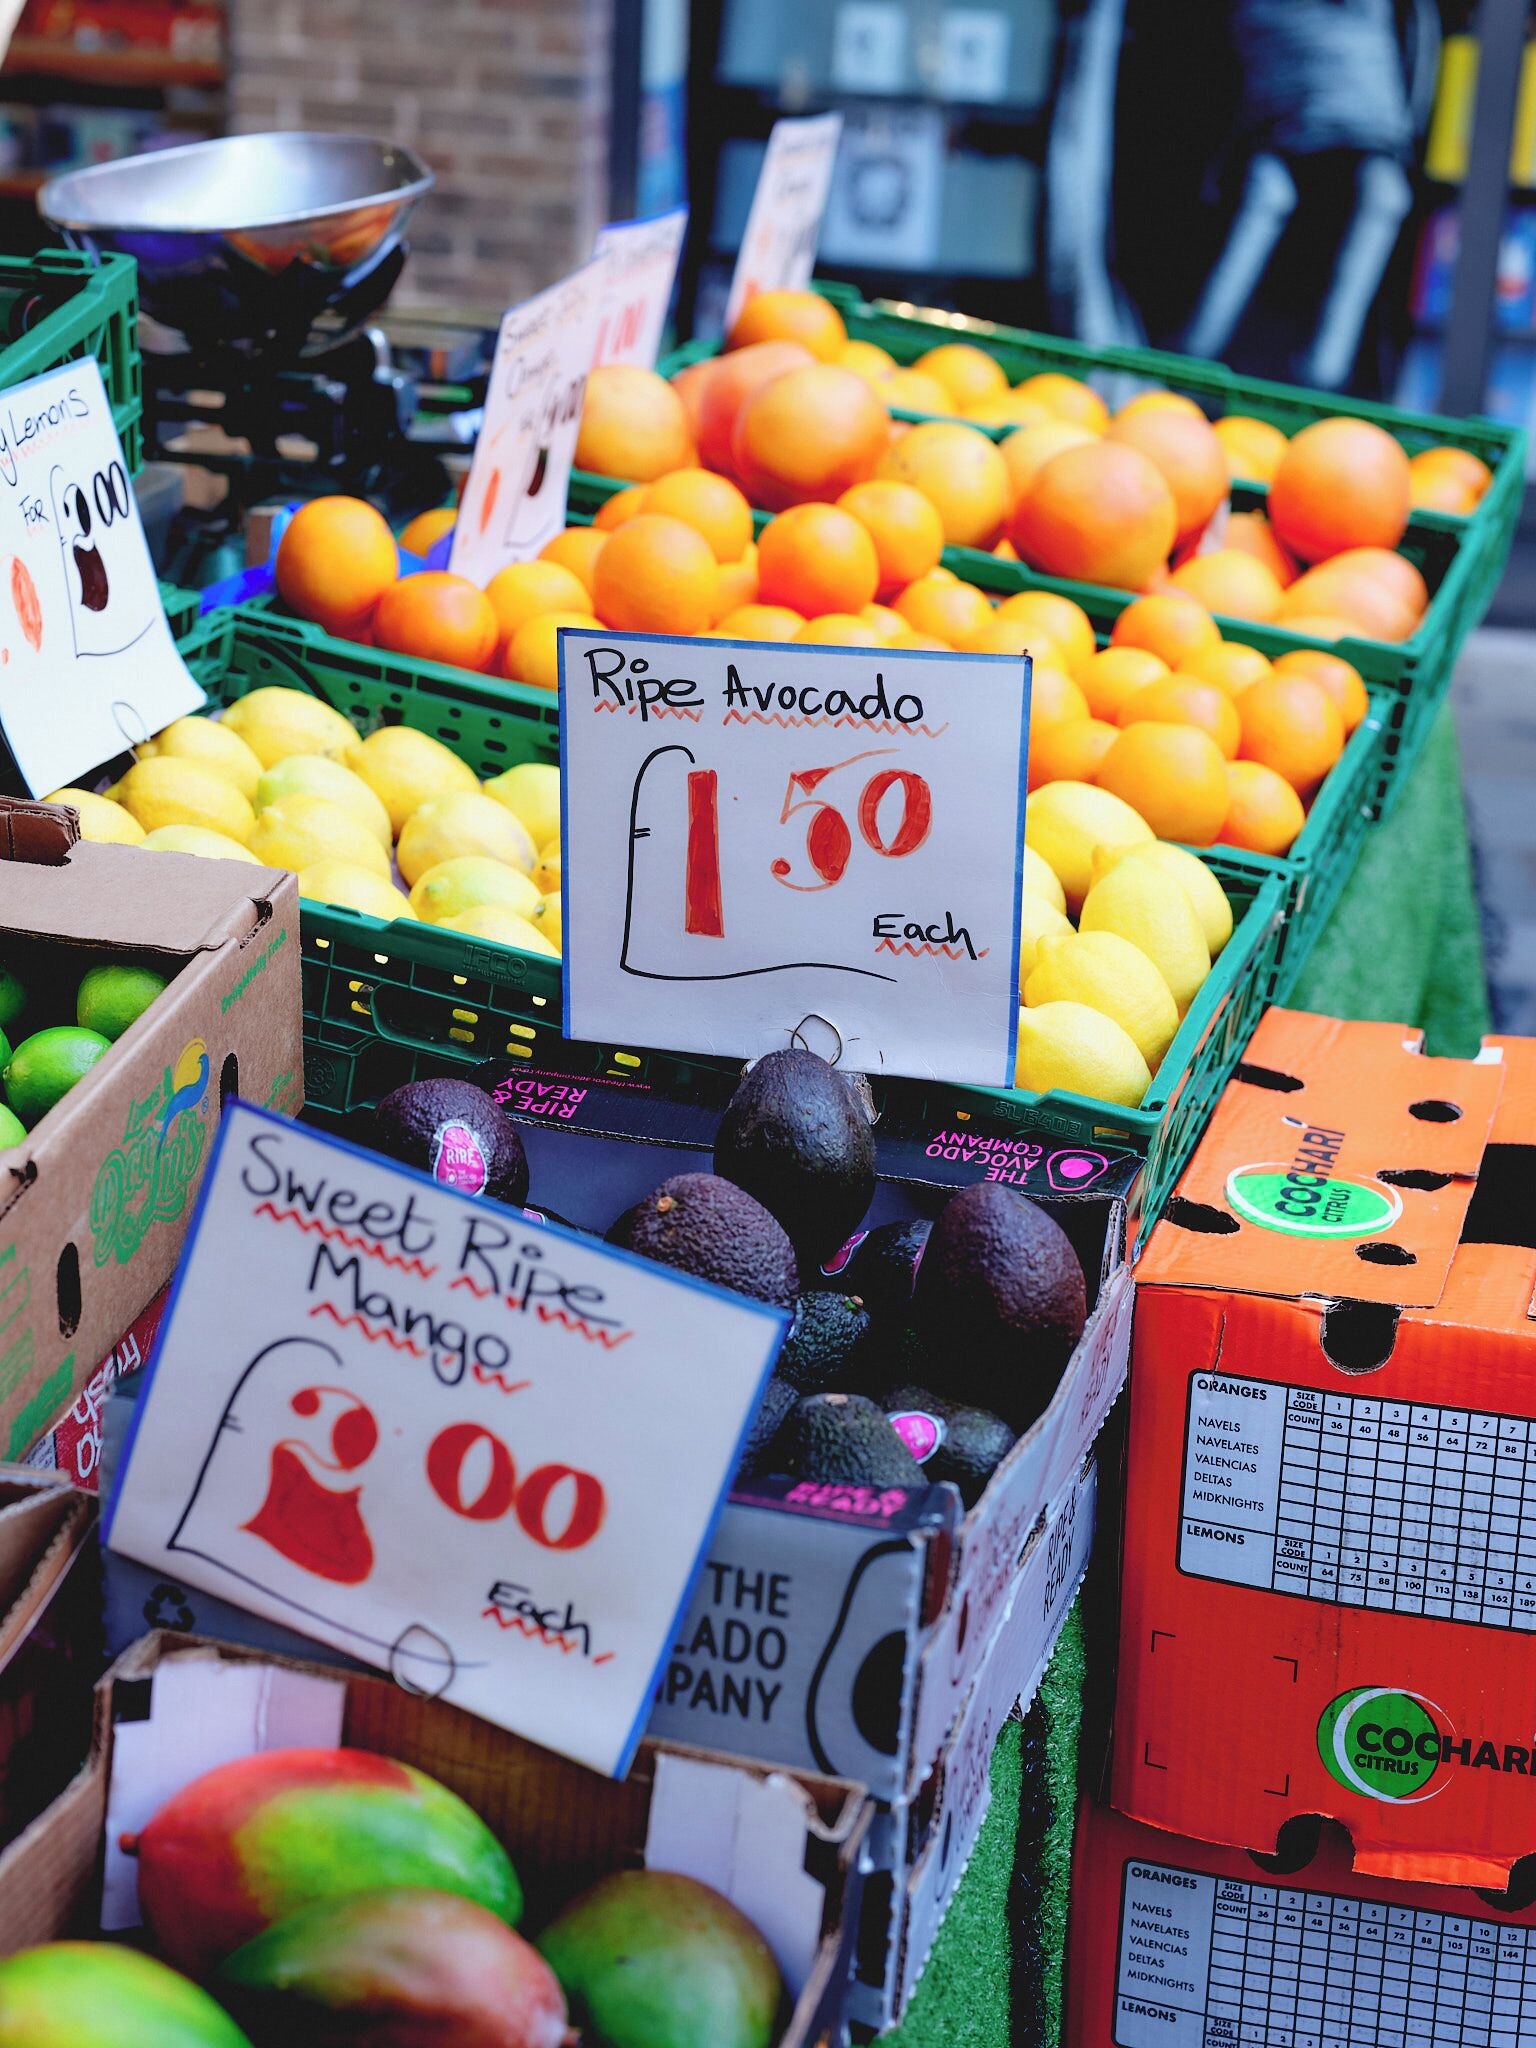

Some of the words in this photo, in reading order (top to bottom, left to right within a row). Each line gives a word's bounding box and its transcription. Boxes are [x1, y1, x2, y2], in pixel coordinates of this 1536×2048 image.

[9, 389, 89, 446] Lemons
[584, 648, 704, 721] Ripe
[723, 664, 924, 724] Avocado
[873, 911, 977, 960] Each
[462, 943, 528, 979] IFCO
[491, 1088, 513, 1104] &
[497, 1077, 588, 1103] READY
[515, 1097, 578, 1119] RIPE
[933, 1131, 1043, 1157] COMPANY
[925, 1143, 1039, 1171] AVOCADO
[985, 1167, 1029, 1184] THE
[1321, 1188, 1351, 1224] CITRUS
[242, 1133, 436, 1254] Sweet
[459, 1216, 622, 1327] Ripe
[308, 1244, 512, 1385] Mango
[1197, 1379, 1268, 1401] ORANGES
[1296, 1391, 1316, 1402] SIZE
[1293, 1400, 1317, 1411] CODE
[1198, 1416, 1241, 1433] NAVELS
[1288, 1413, 1320, 1426] COUNT
[1330, 1421, 1343, 1430] 36
[1359, 1426, 1371, 1434] 40
[1387, 1429, 1400, 1438] 48
[1416, 1433, 1429, 1442] 56
[1446, 1437, 1458, 1446] 64
[1476, 1441, 1488, 1450] 72
[1504, 1445, 1517, 1454] 88
[1196, 1434, 1259, 1455] NAVELATES
[1195, 1453, 1257, 1473] VALENCIAS
[1194, 1471, 1232, 1487] DELTAS
[1192, 1489, 1264, 1512] MIDKNIGHTS
[1187, 1524, 1245, 1545] LEMONS
[1284, 1540, 1303, 1549] SIZE
[1281, 1548, 1305, 1558] CODE
[1043, 1526, 1076, 1621] READY
[1277, 1561, 1308, 1573] COUNT
[1321, 1568, 1334, 1577] 64
[1350, 1573, 1362, 1582] 75
[1378, 1577, 1390, 1586] 88
[1404, 1581, 1422, 1590] 100
[1434, 1585, 1450, 1595] 113
[1462, 1590, 1479, 1599] 138
[1492, 1594, 1508, 1604] 162
[1519, 1598, 1536, 1608] 189
[707, 1561, 791, 1618] THE
[488, 1582, 591, 1657] Each
[674, 1615, 786, 1670] ADO
[655, 1662, 782, 1722] PANY
[1354, 1753, 1418, 1776] CITRUS
[1131, 1867, 1197, 1890] ORANGES
[1224, 1882, 1243, 1892] SIZE
[1132, 1901, 1172, 1918] NAVELS
[1221, 1890, 1244, 1901] CODE
[1480, 1928, 1490, 1936] 10
[1507, 1933, 1518, 1942] 12
[1131, 1918, 1190, 1939] NAVELATES
[1217, 1902, 1247, 1915] COUNT
[1257, 1910, 1269, 1918] 36
[1284, 1914, 1296, 1922] 40
[1311, 1918, 1323, 1926] 48
[1338, 1922, 1350, 1931] 56
[1366, 1927, 1378, 1936] 64
[1393, 1931, 1405, 1940] 72
[1421, 1936, 1432, 1944] 88
[1448, 1941, 1463, 1950] 105
[1475, 1946, 1491, 1955] 125
[1502, 1950, 1518, 1959] 144
[1129, 1935, 1188, 1957] VALENCIAS
[1128, 1952, 1165, 1968] DELTAS
[1127, 1969, 1195, 1993] MIDKNIGHTS
[1121, 2001, 1177, 2023] LEMONS
[1213, 2019, 1232, 2028] SIZE
[1210, 2027, 1233, 2038] CODE
